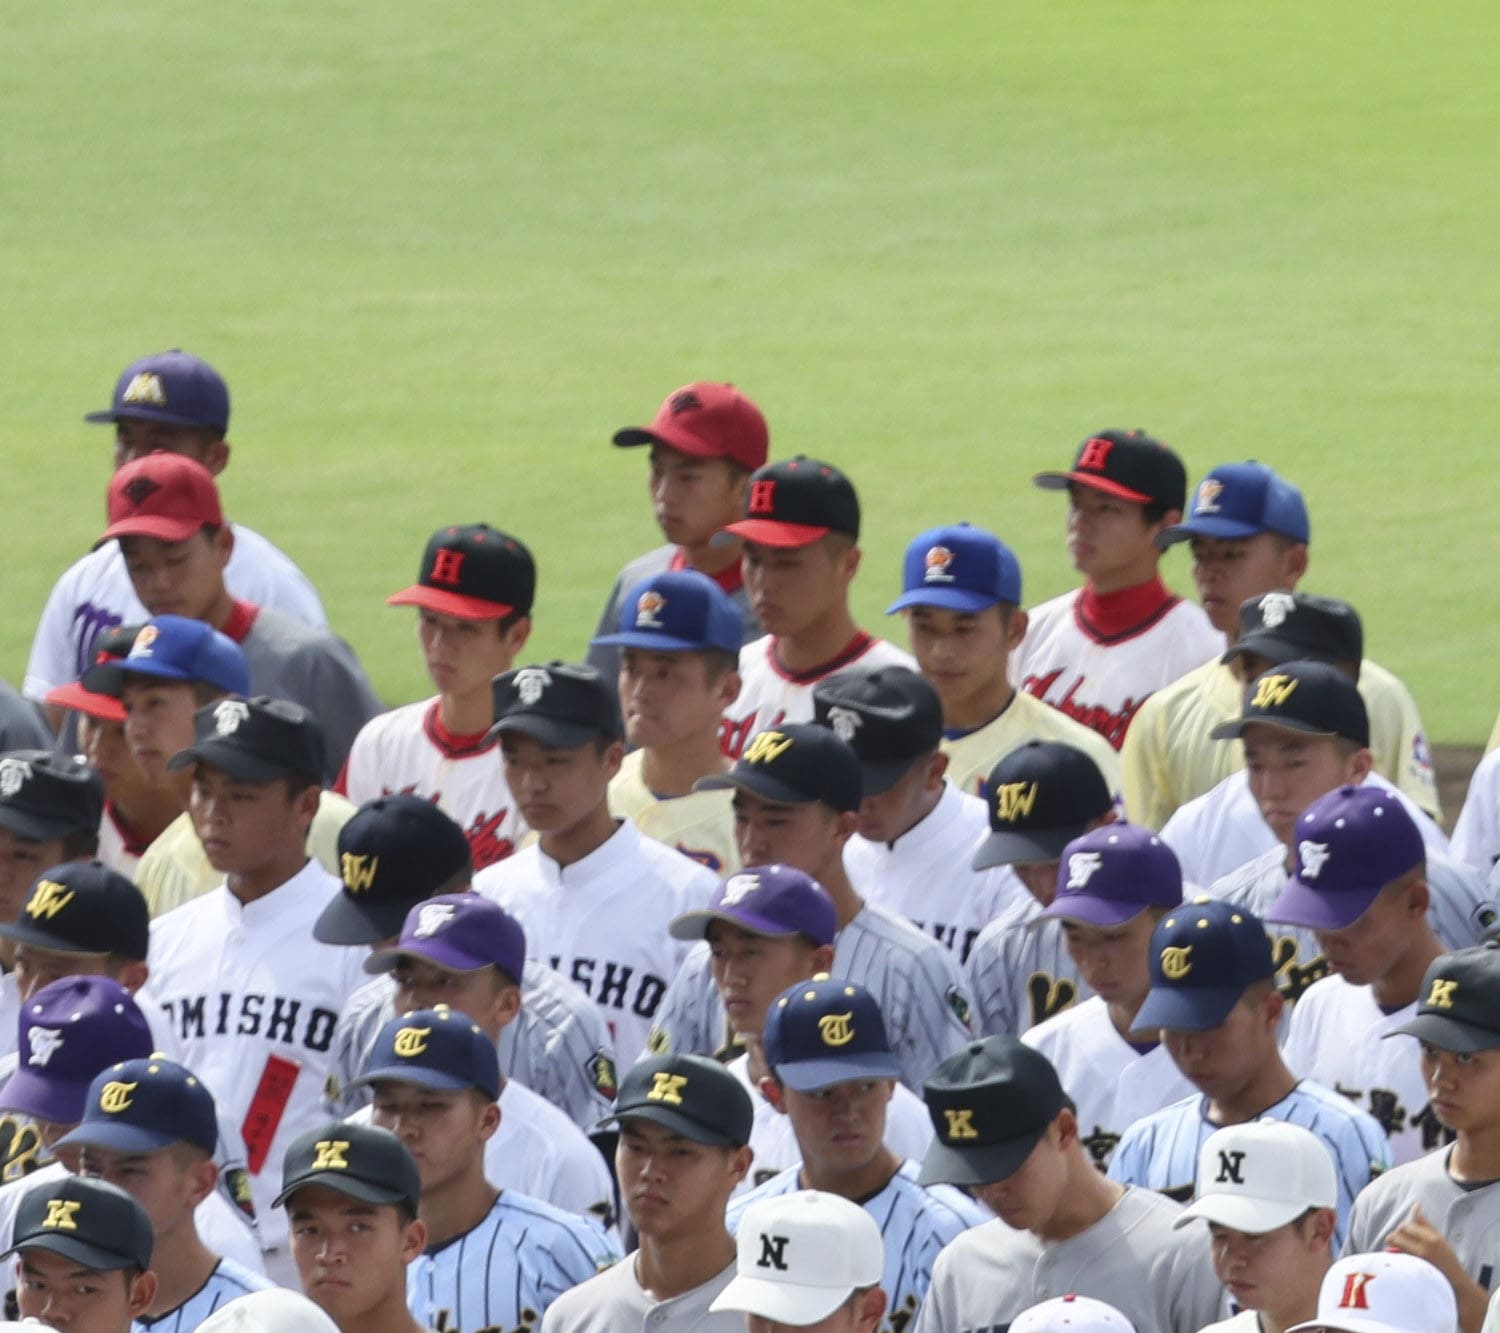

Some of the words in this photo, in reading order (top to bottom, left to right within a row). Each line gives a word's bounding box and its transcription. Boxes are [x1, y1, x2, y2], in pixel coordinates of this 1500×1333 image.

[1425, 979, 1456, 1009] K
[649, 1073, 688, 1105] K
[1215, 1151, 1245, 1185] N
[43, 1200, 80, 1230] K
[757, 1233, 790, 1272] N
